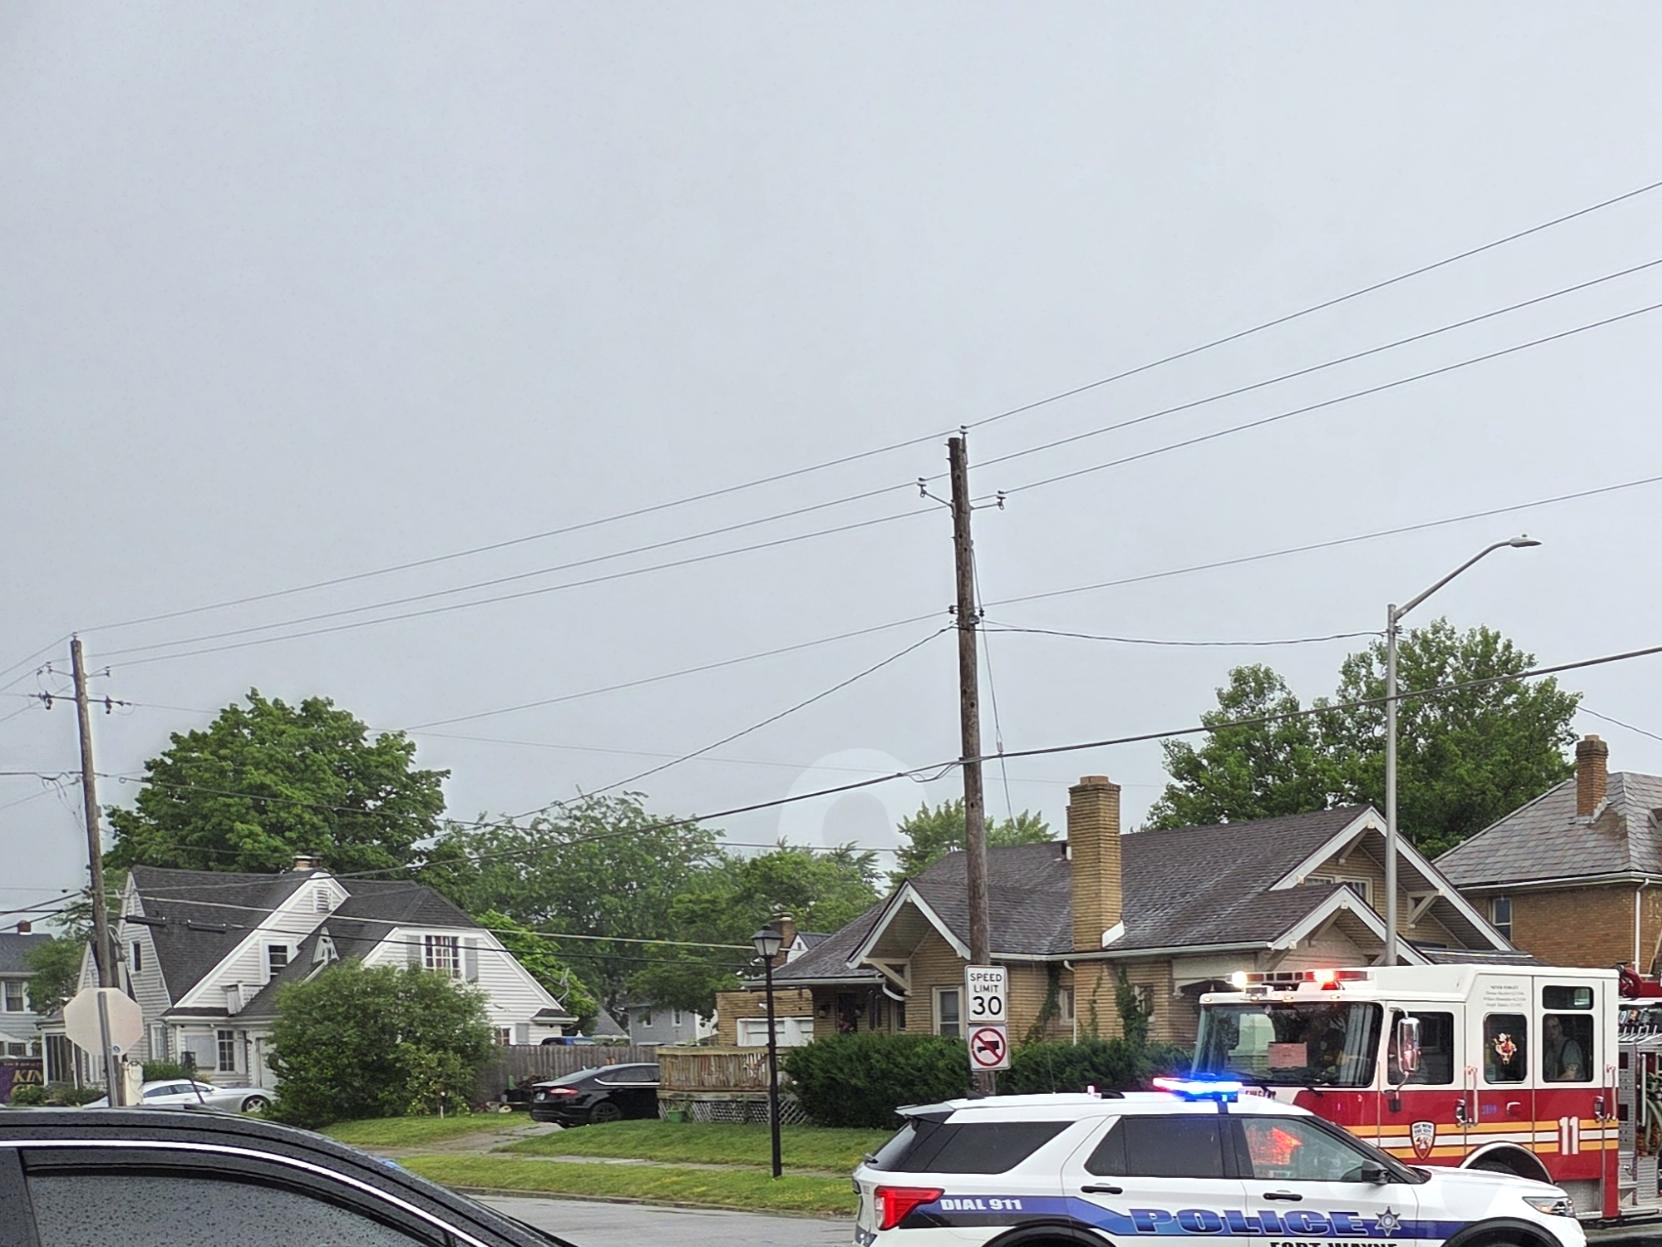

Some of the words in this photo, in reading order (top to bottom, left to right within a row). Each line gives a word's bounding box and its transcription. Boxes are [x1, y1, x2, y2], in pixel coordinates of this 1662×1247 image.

[970, 973, 1002, 982] SPEED
[974, 985, 998, 993] LIMIT
[972, 996, 1002, 1015] 30
[1559, 1116, 1579, 1155] 11
[940, 1199, 986, 1211] DIAL
[989, 1199, 1022, 1210] 911
[1128, 1208, 1368, 1236] POLICE
